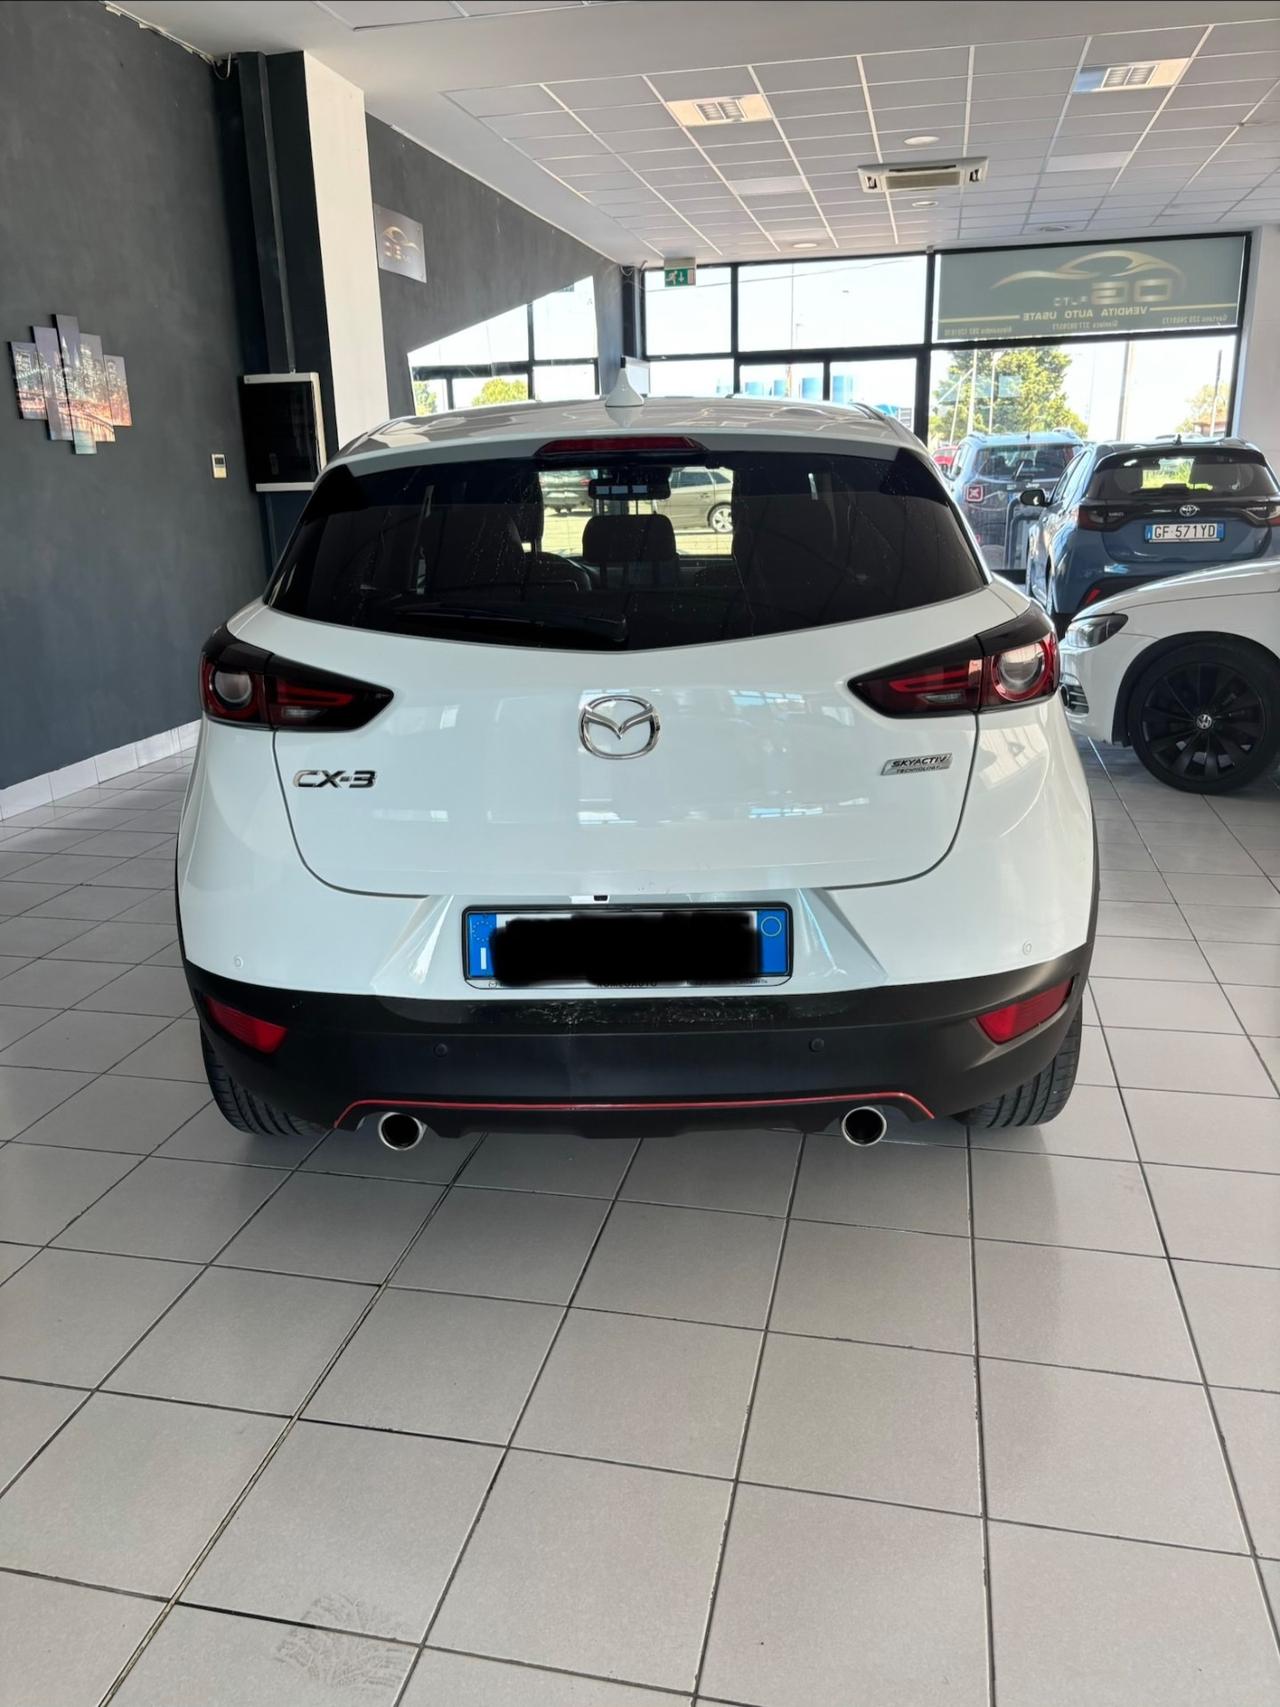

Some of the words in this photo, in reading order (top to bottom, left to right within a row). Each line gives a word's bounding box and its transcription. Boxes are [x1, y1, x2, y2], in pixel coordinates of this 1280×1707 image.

[1154, 525, 1170, 538] GF
[1175, 524, 1216, 538] 571YD
[891, 756, 947, 767] SKYACTIV
[293, 769, 378, 788] CX-3
